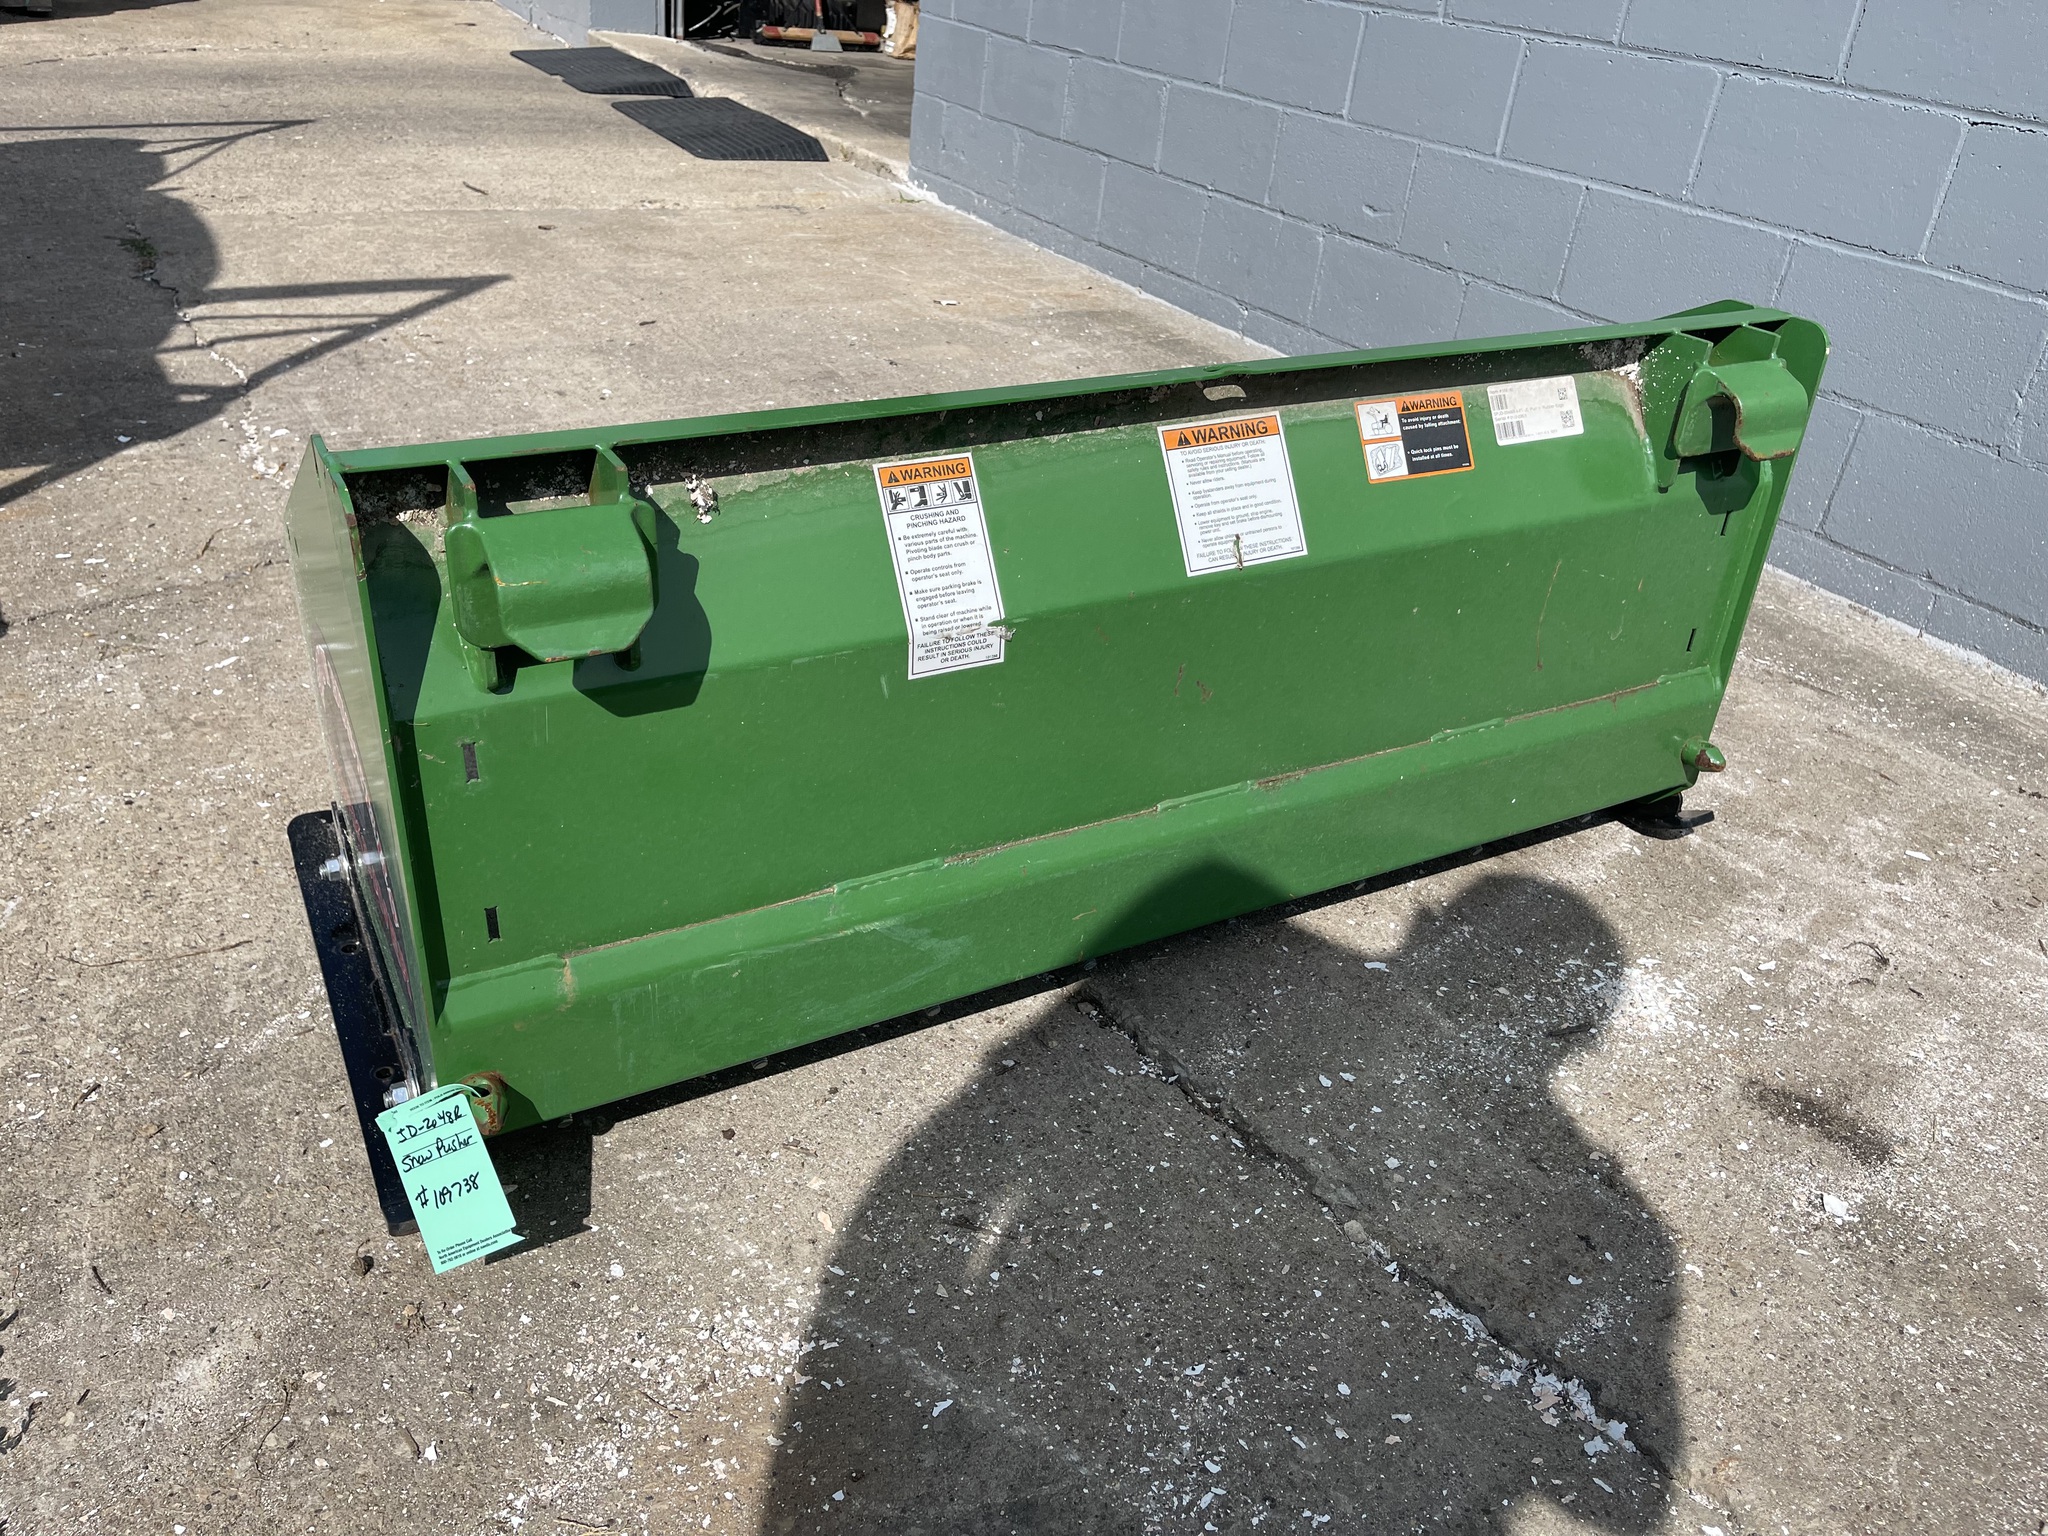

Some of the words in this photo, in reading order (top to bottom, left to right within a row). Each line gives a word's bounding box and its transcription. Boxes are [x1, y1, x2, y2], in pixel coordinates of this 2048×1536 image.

[1409, 397, 1457, 410] WARNING
[1192, 422, 1268, 444] WARNING
[900, 463, 966, 481] WARNING
[910, 511, 944, 520] CRUSHING
[907, 519, 938, 528] PINCHING
[940, 515, 966, 524] HAZARD
[912, 531, 936, 539] extremely
[925, 538, 938, 546] parts
[908, 554, 922, 562] pinch
[1197, 550, 1216, 558] FAILURE
[910, 567, 930, 575] Operate
[912, 573, 937, 582] operator's
[942, 583, 961, 591] parking
[916, 593, 938, 601] engaged
[917, 600, 943, 609] operator's
[928, 619, 952, 628] operation
[917, 640, 938, 648] FAILURE
[951, 634, 975, 642] FOLLOW
[977, 630, 995, 638] THESE
[925, 642, 966, 653] INSTRUCTIONS
[918, 653, 939, 661] RESULT
[948, 647, 972, 656] SERIOUS
[401, 1150, 432, 1173] Snow
[436, 1134, 472, 1157] Pusher
[448, 1248, 462, 1256] American
[463, 1240, 480, 1250] Equipment
[493, 1229, 510, 1238] Association
